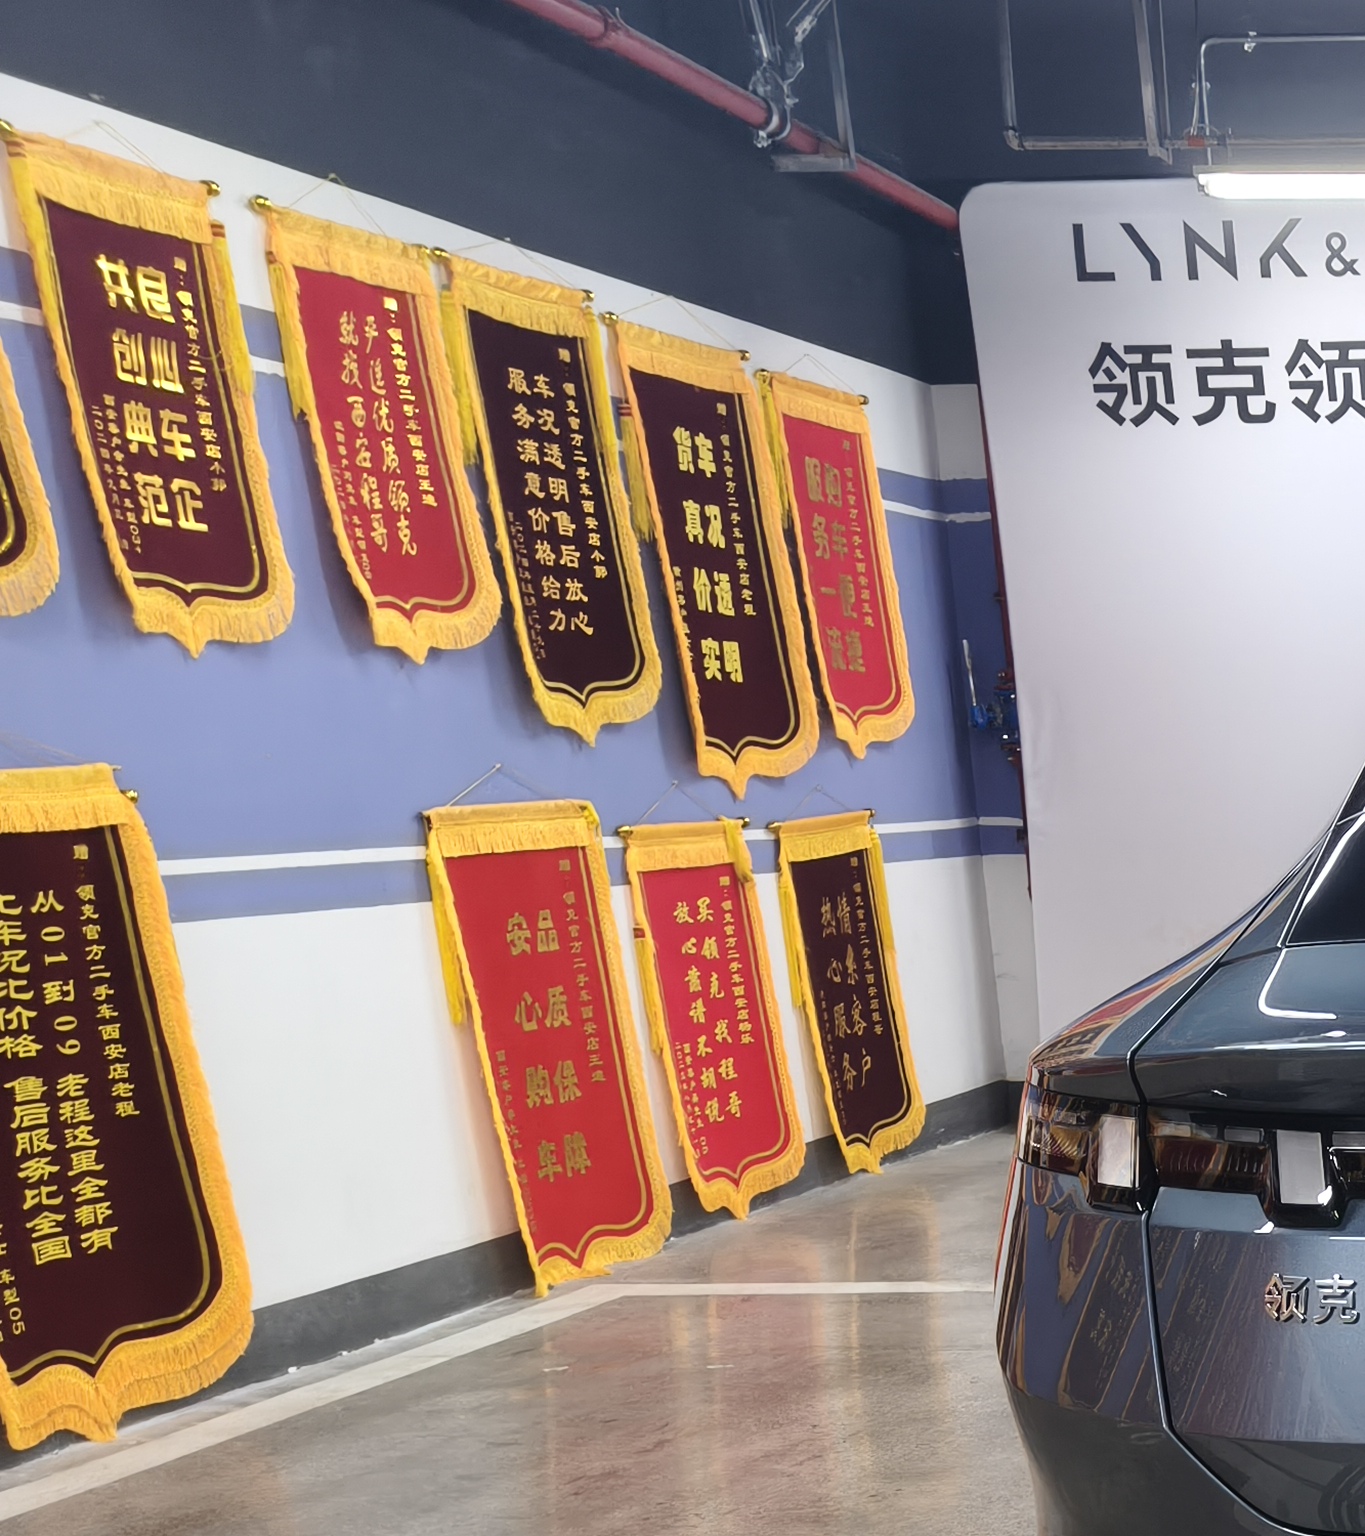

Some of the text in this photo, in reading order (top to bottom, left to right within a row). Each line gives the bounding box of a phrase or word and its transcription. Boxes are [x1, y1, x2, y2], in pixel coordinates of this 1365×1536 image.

[95, 253, 173, 528] 共创典范
[507, 366, 567, 632] 服务满意价格给力
[531, 372, 594, 636] 车况透明售后放心
[672, 415, 722, 682] 货真价实
[694, 431, 743, 684] 车况透明
[3, 1076, 72, 1265] 售后服务比全国
[57, 1072, 118, 1254] 老程这里全都有
[506, 912, 562, 1182] 安心购车
[537, 909, 591, 1179] 品质保障
[1264, 1272, 1359, 1325] 领克
